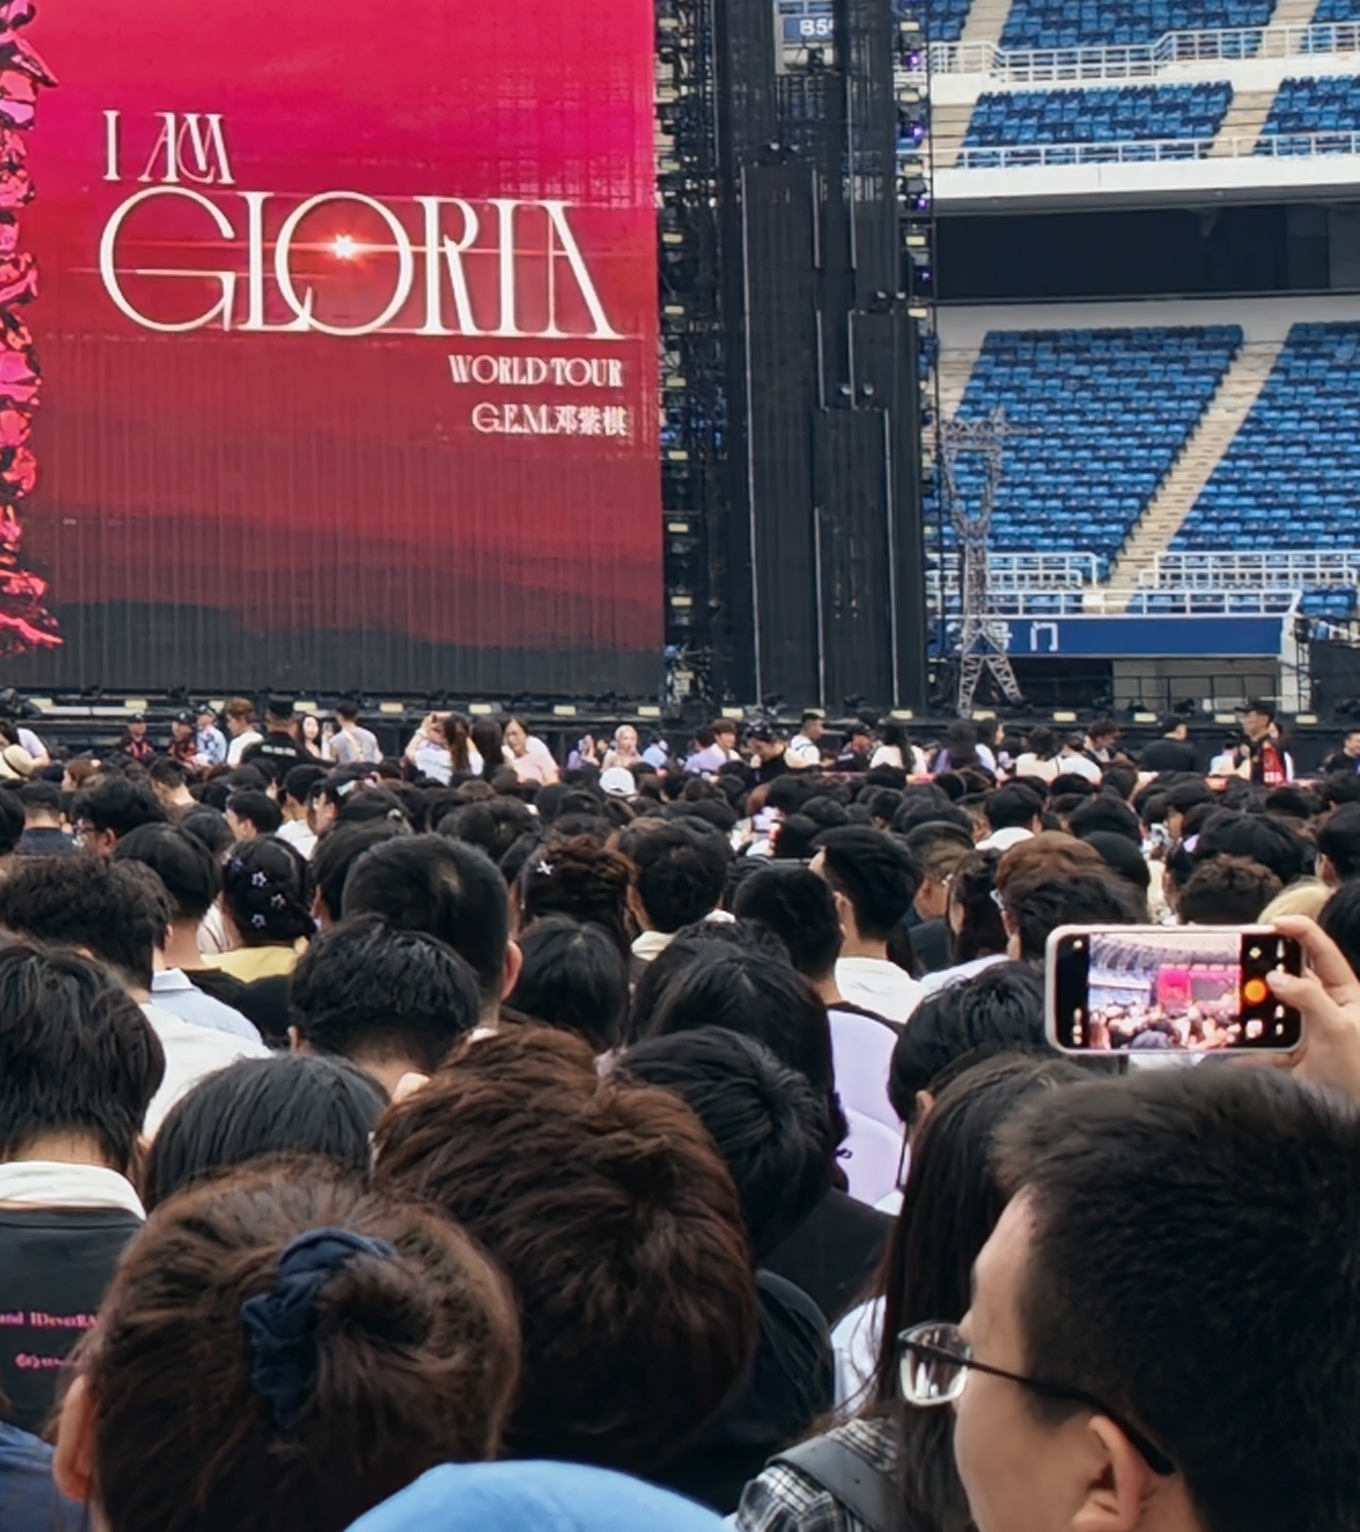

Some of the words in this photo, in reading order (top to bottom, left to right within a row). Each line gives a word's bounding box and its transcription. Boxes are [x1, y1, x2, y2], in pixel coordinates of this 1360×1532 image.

[102, 109, 122, 182] I
[138, 111, 236, 185] AM
[98, 185, 625, 339] GLORIA
[448, 354, 548, 385] WORLD
[550, 357, 624, 387] TOUR
